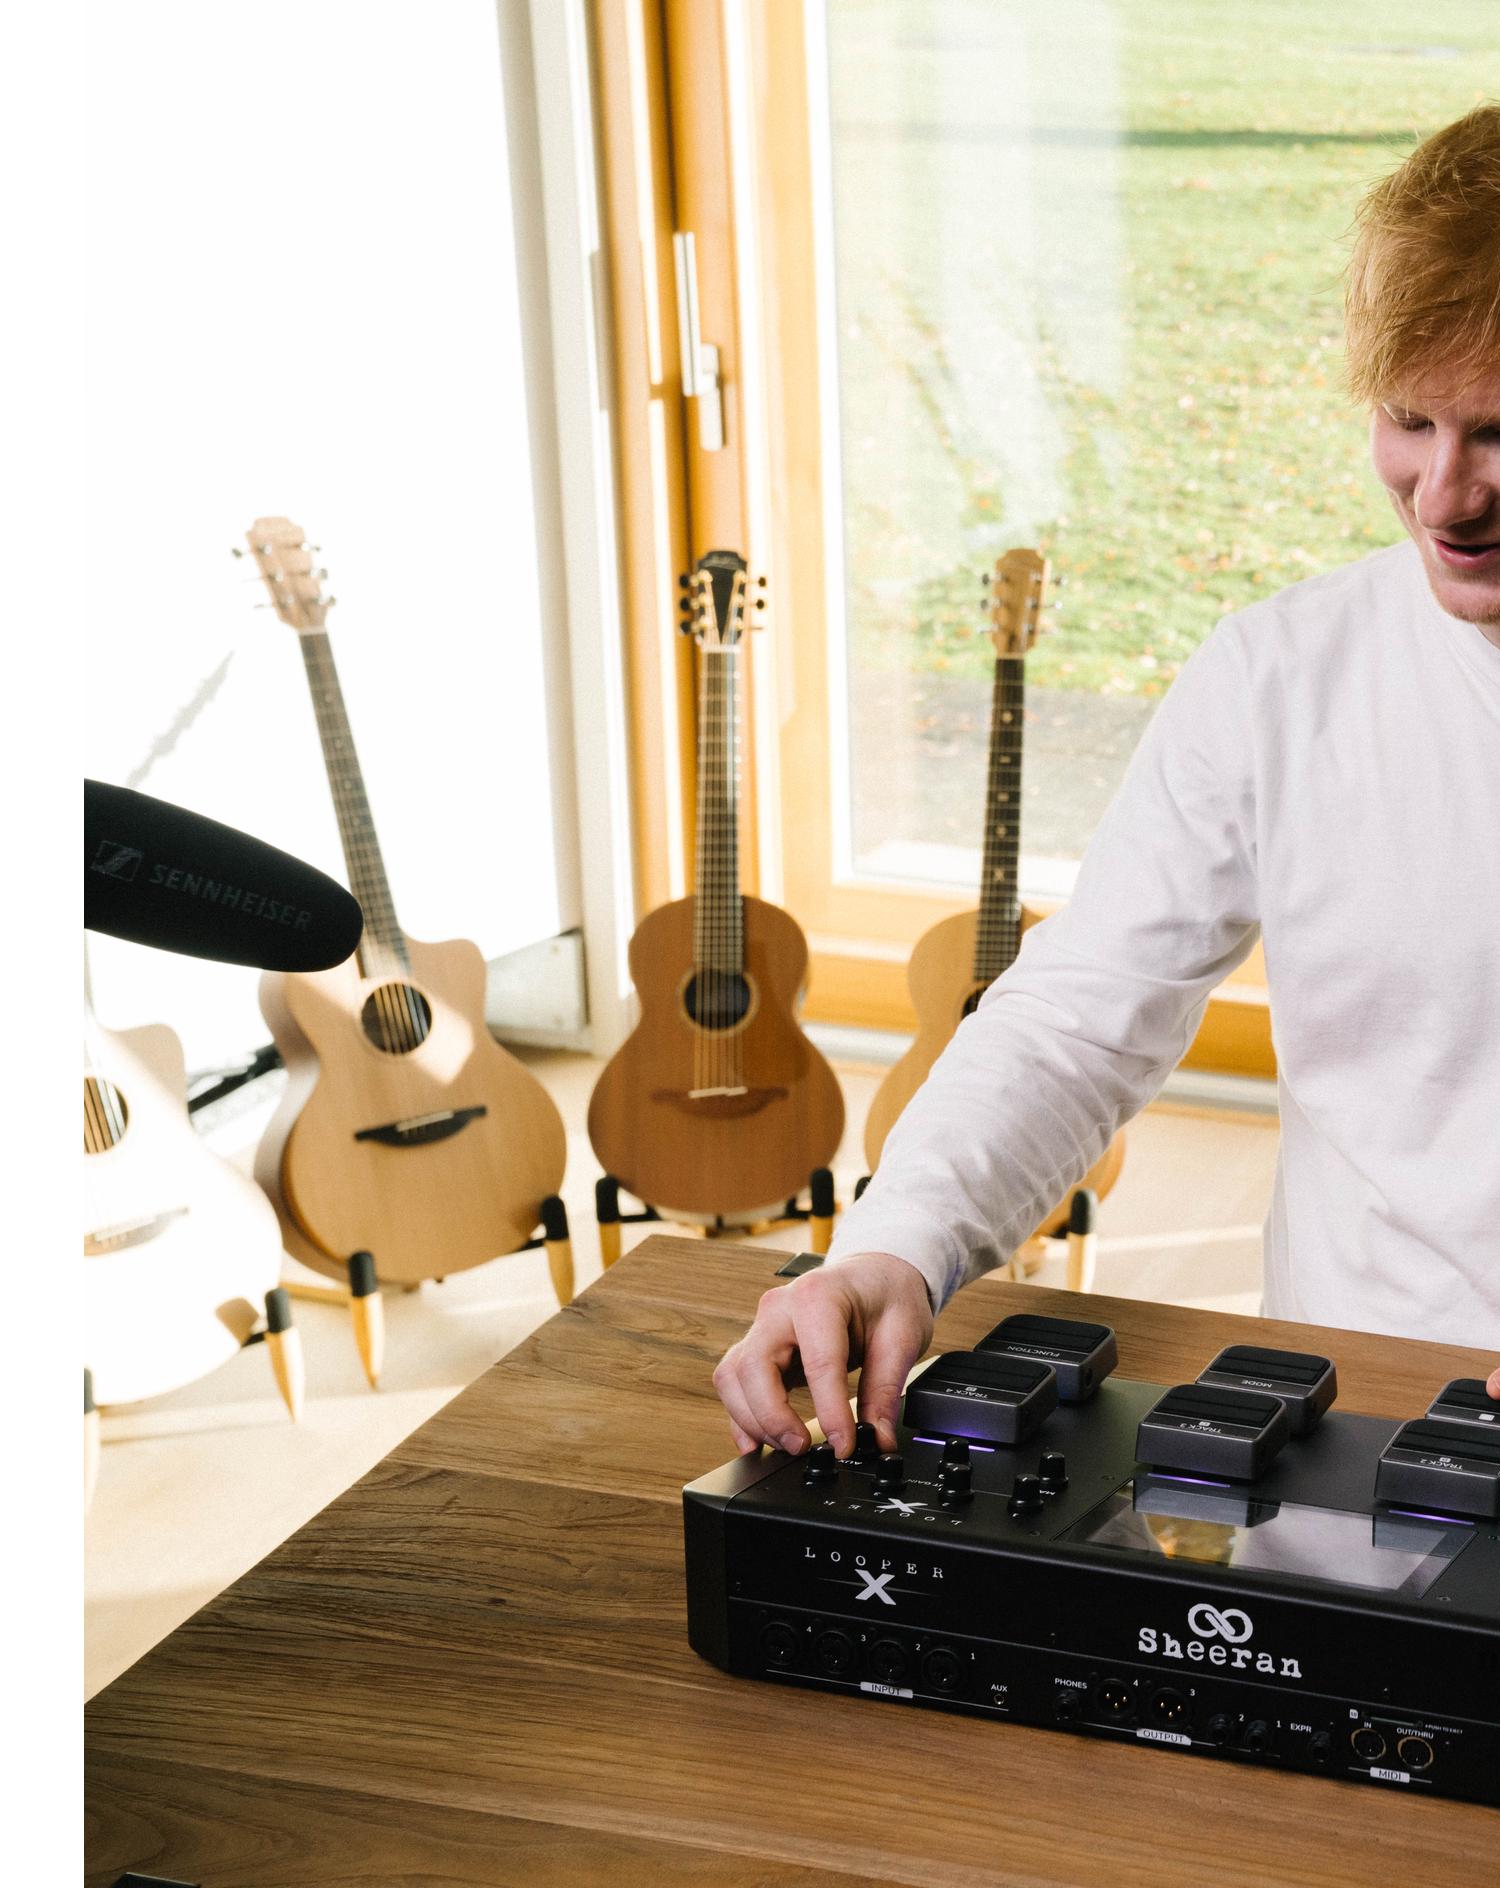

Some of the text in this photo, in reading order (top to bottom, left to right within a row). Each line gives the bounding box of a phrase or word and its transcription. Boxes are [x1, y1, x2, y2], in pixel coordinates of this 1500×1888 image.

[149, 864, 312, 930] SENNHEISER
[1007, 1345, 1060, 1358] FUNCTION
[1241, 1379, 1273, 1388] MODE
[954, 1388, 988, 1399] TRACK
[1188, 1424, 1222, 1433] TRACK
[1426, 1459, 1464, 1471] TRACK
[804, 1547, 944, 1579] LOOPER
[855, 1568, 896, 1605] X
[860, 1634, 866, 1642] 3
[915, 1643, 921, 1651] 2
[1138, 1627, 1302, 1679] Sheeran
[990, 1683, 1008, 1693] AUX
[1054, 1677, 1088, 1689] PHONES
[871, 1684, 901, 1696] INPUT
[1190, 1688, 1196, 1697] 3
[1239, 1714, 1245, 1722] 2
[1290, 1722, 1312, 1733] EXPR
[1364, 1721, 1372, 1729] IN
[1142, 1729, 1184, 1743] OUTPUT
[1396, 1727, 1434, 1739] OUT/THRU
[1378, 1769, 1402, 1781] MIDI
